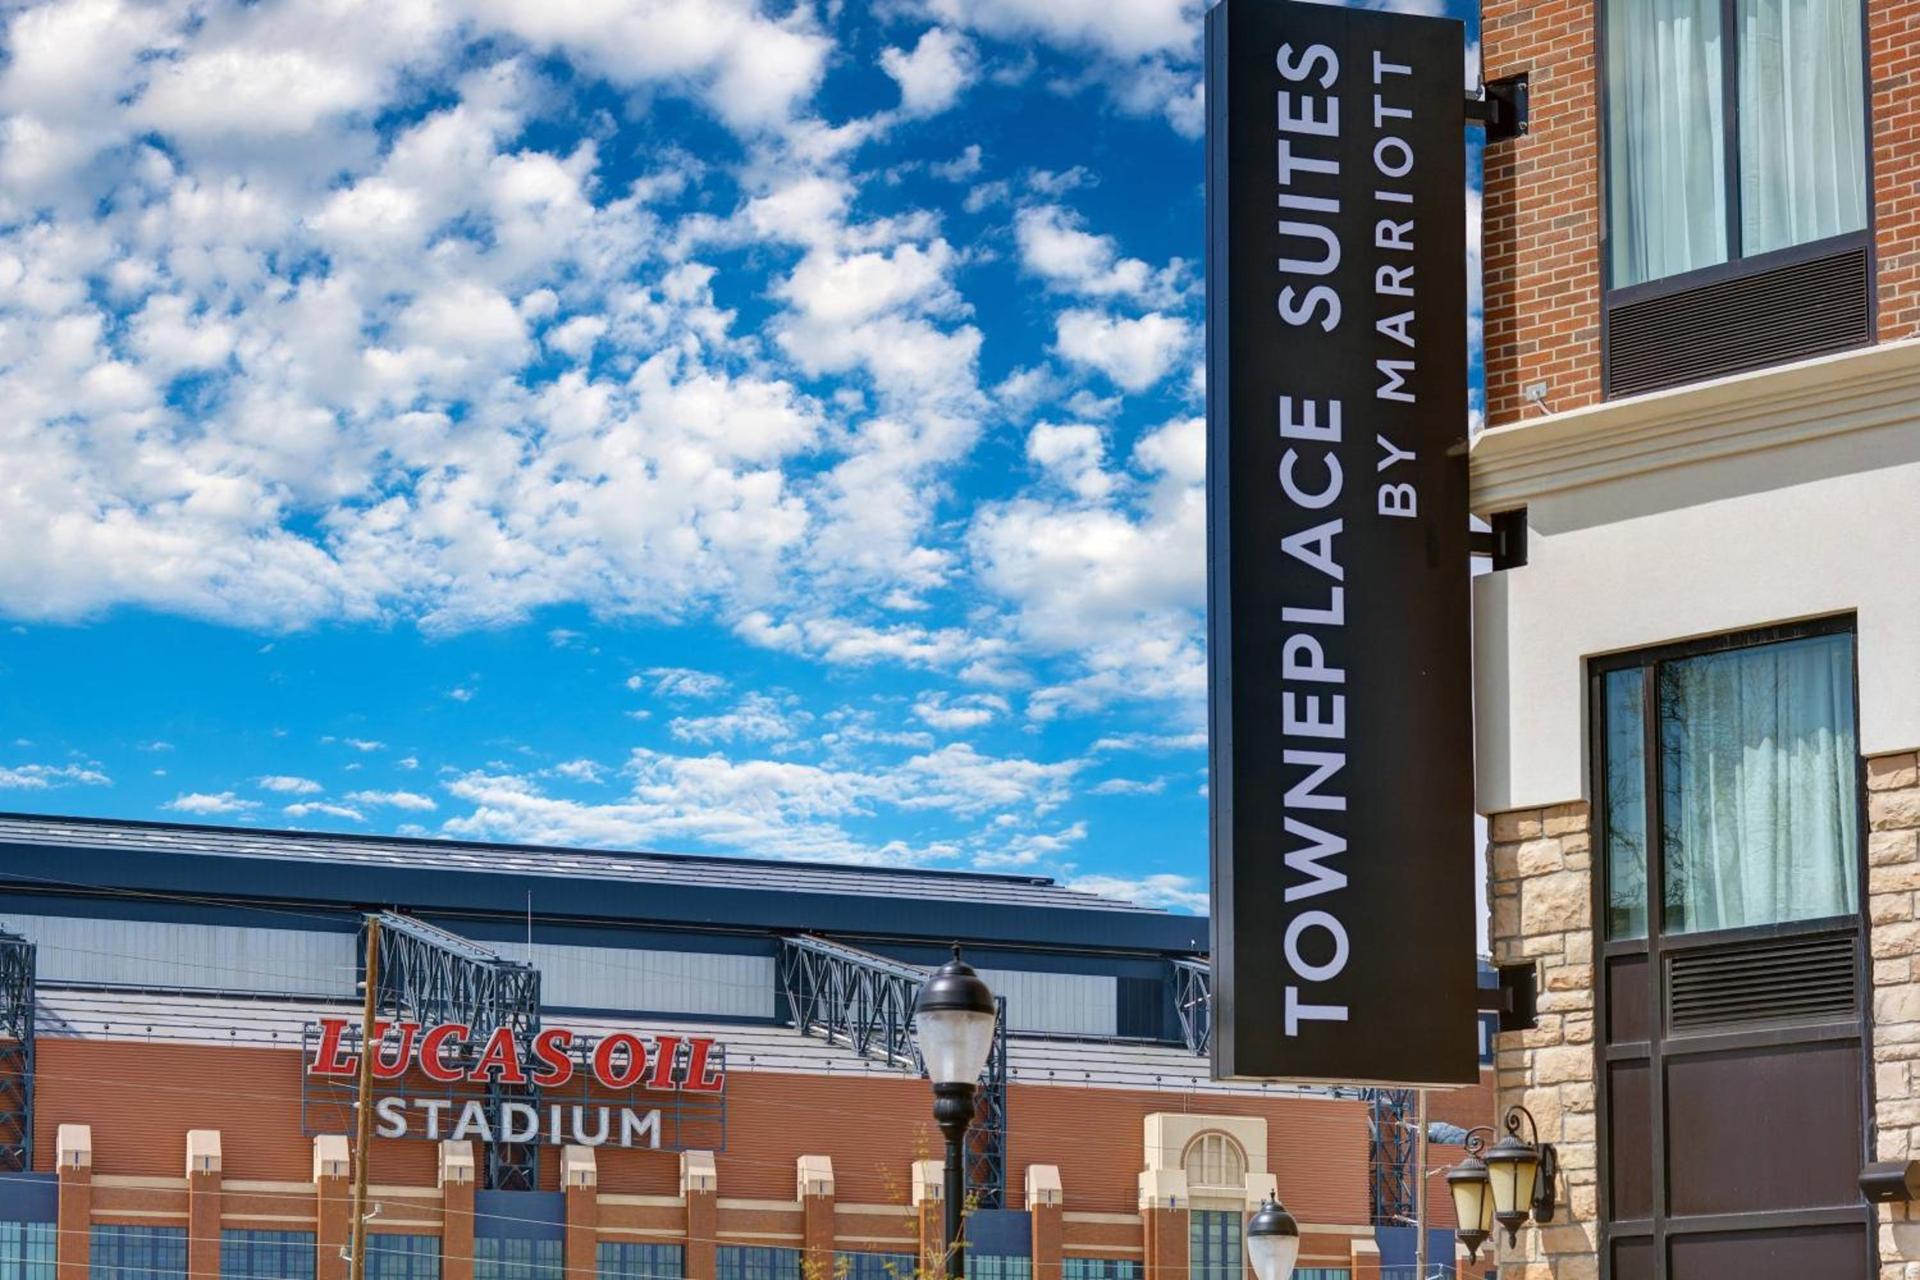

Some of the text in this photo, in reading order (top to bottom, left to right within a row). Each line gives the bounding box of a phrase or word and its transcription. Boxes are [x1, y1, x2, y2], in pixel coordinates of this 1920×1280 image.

[1373, 50, 1417, 518] BY MARRIOTT
[1276, 42, 1350, 1037] TOWNEPLACE SUITES
[307, 1017, 725, 1093] LUCAS OIL
[376, 1097, 661, 1149] STADIUM
